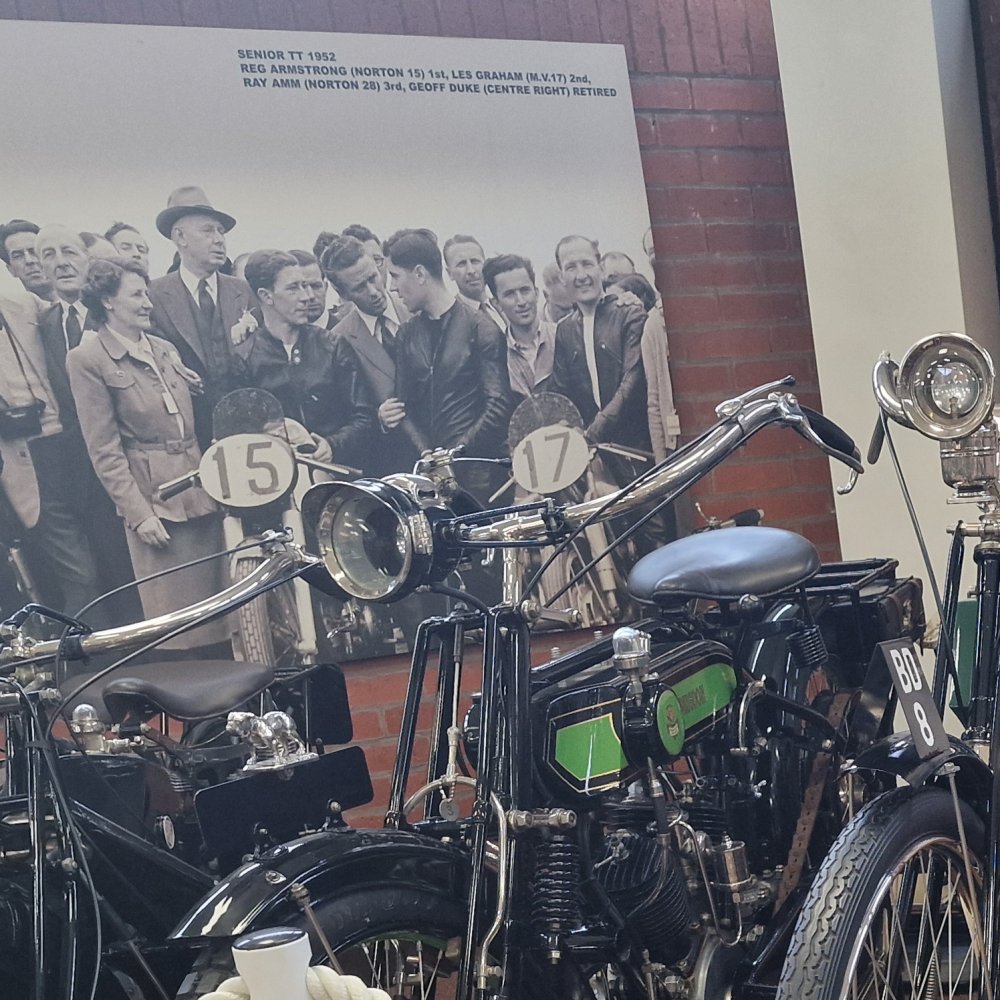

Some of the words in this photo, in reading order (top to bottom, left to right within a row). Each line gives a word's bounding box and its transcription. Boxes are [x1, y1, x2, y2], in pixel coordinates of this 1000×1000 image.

[237, 48, 285, 60] SENIOR
[287, 50, 303, 61] TT
[307, 50, 336, 62] 1952
[240, 63, 266, 73] REG
[270, 63, 347, 76] ARMSTRONG
[350, 66, 404, 80] (NORTON
[407, 67, 425, 80] 15)
[428, 68, 449, 80] 1st,
[451, 69, 472, 79] LES
[475, 70, 523, 81] GRAHAM
[569, 73, 591, 85] 2nd,
[242, 77, 267, 88] RAY
[271, 77, 301, 88] AMM
[304, 78, 359, 91] (NORTON
[362, 80, 380, 93] 28)
[383, 80, 406, 93] 3rd,
[408, 81, 445, 92] GEOFF
[448, 82, 480, 93] DUKE
[483, 83, 530, 96] (CENTRE
[533, 85, 570, 98] RIGHT)
[572, 86, 616, 96] RETIRED
[211, 441, 279, 500] 15
[523, 431, 572, 490] 17
[890, 648, 922, 693] BD
[914, 702, 935, 747] 8
